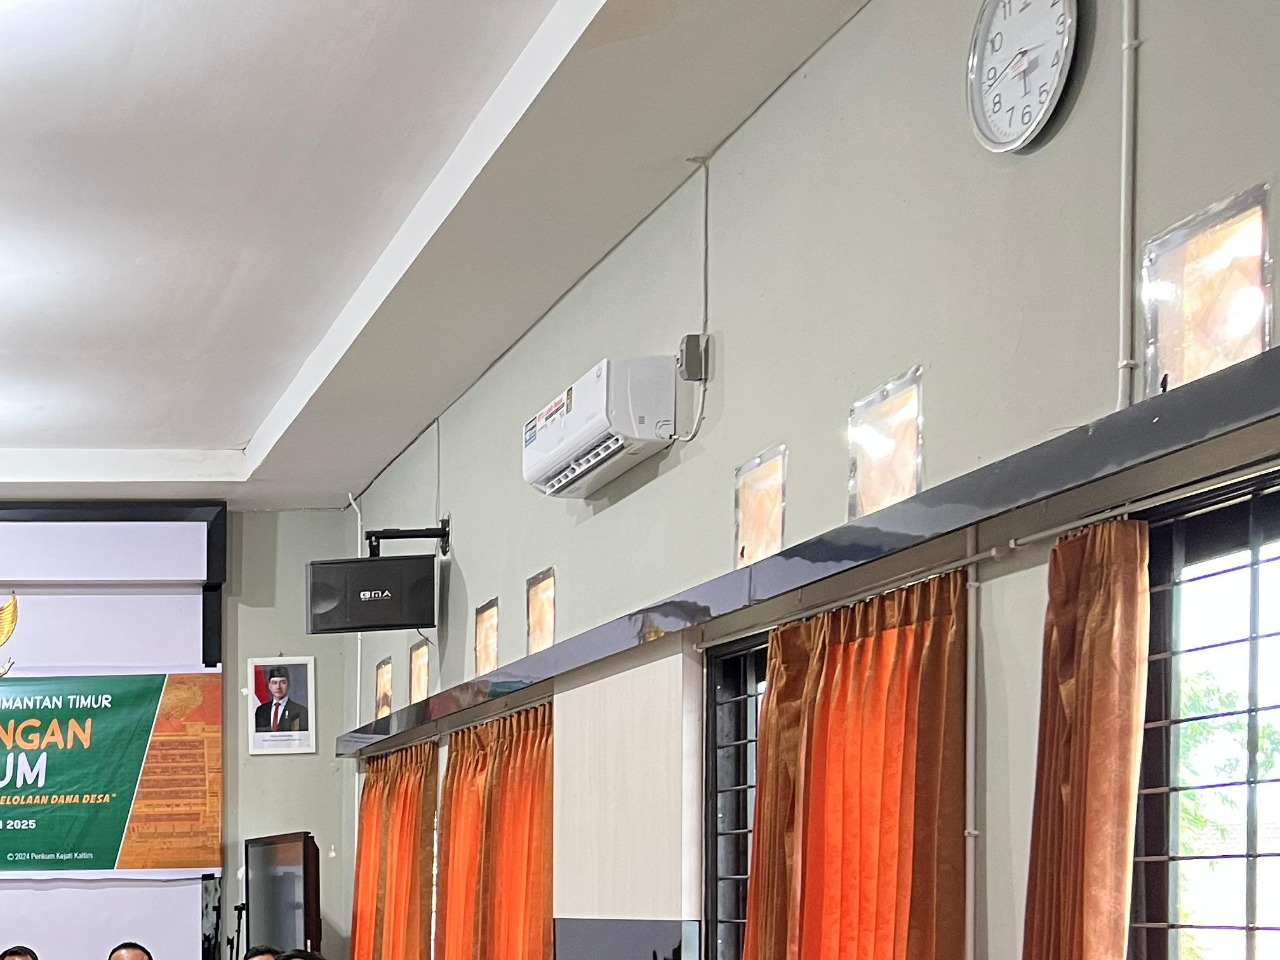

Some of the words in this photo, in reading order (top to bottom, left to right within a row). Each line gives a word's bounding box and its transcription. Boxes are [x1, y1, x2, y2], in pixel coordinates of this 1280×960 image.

[992, 93, 1002, 114] 8
[1038, 81, 1050, 105] 5
[1005, 105, 1016, 128] 7
[1021, 104, 1033, 126] 6
[67, 694, 112, 709] TIMUR
[51, 794, 80, 805] DANA
[6, 819, 37, 830] 2025
